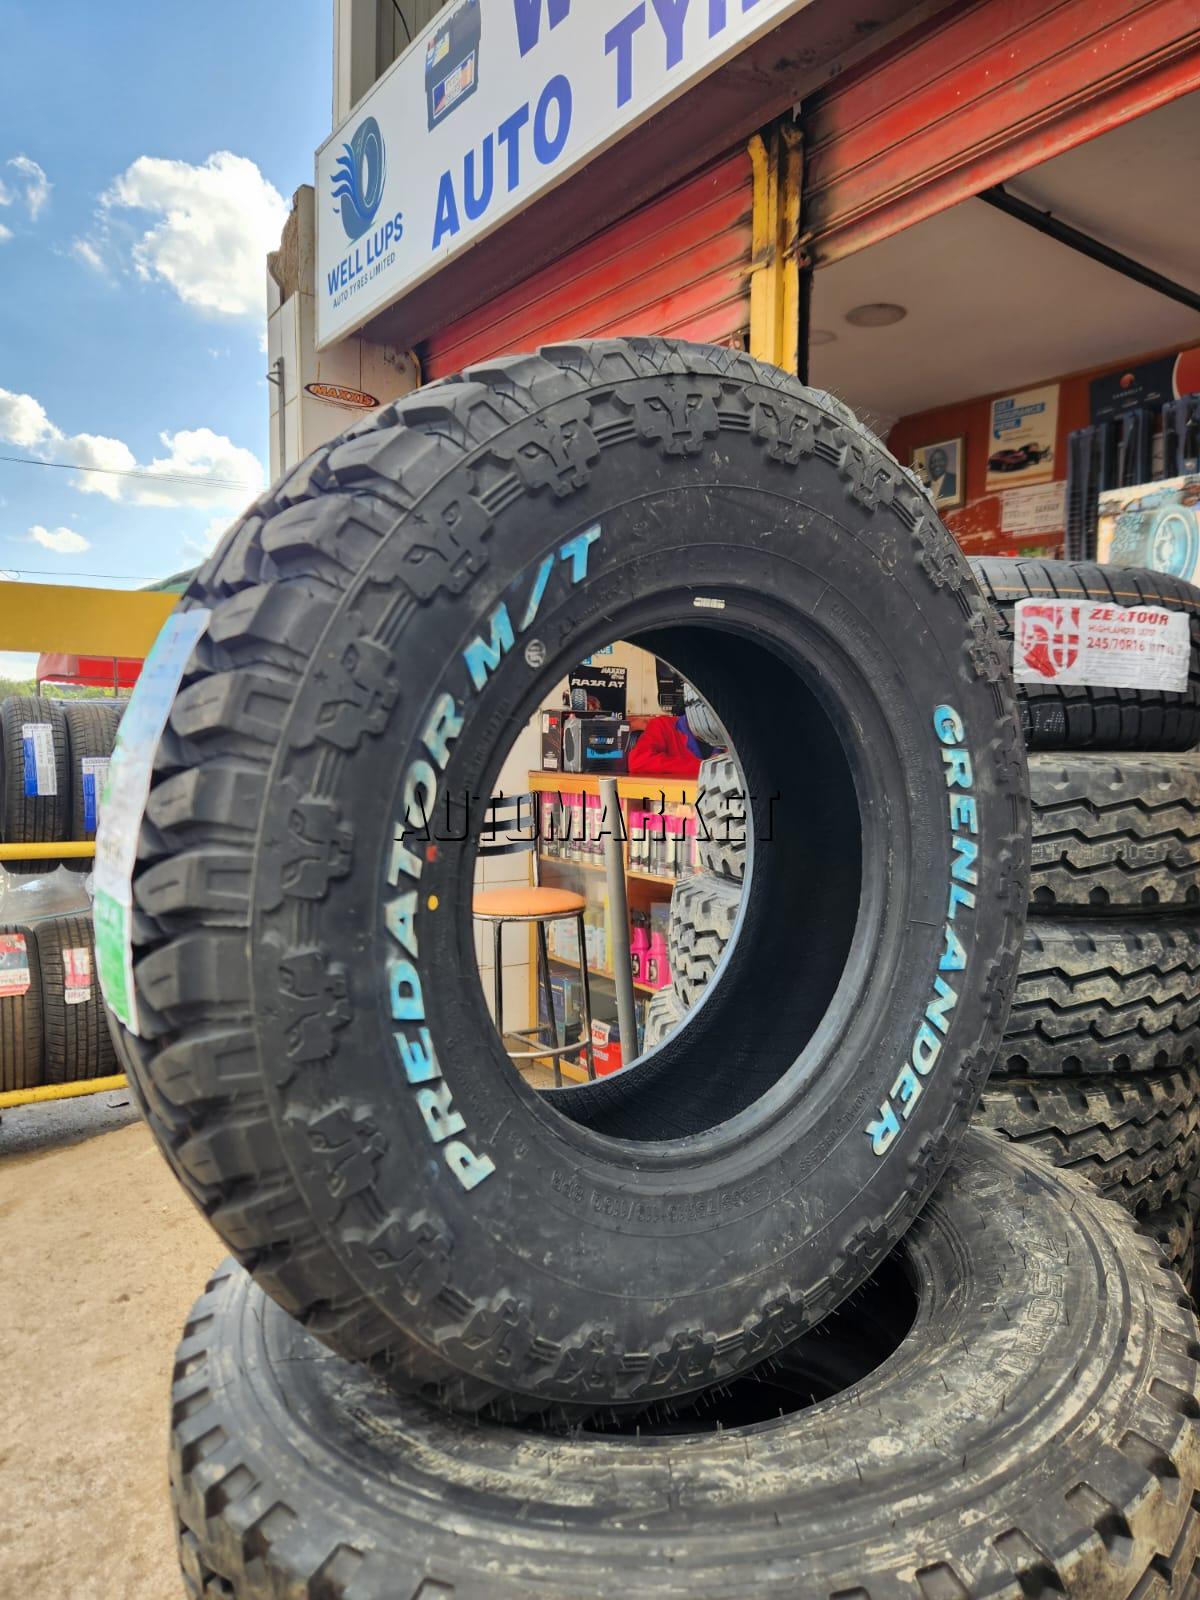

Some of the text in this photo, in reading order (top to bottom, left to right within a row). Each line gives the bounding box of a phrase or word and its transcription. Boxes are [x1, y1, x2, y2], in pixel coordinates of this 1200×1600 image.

[432, 0, 761, 250] AUTO TY
[327, 211, 404, 296] WELL LUPS
[333, 252, 396, 309] AUTO TYRES LIMITED
[463, 523, 602, 692] M/T
[607, 680, 625, 688] AT
[384, 692, 497, 1192] PREDATOR
[865, 703, 979, 1157] GRENLANDER
